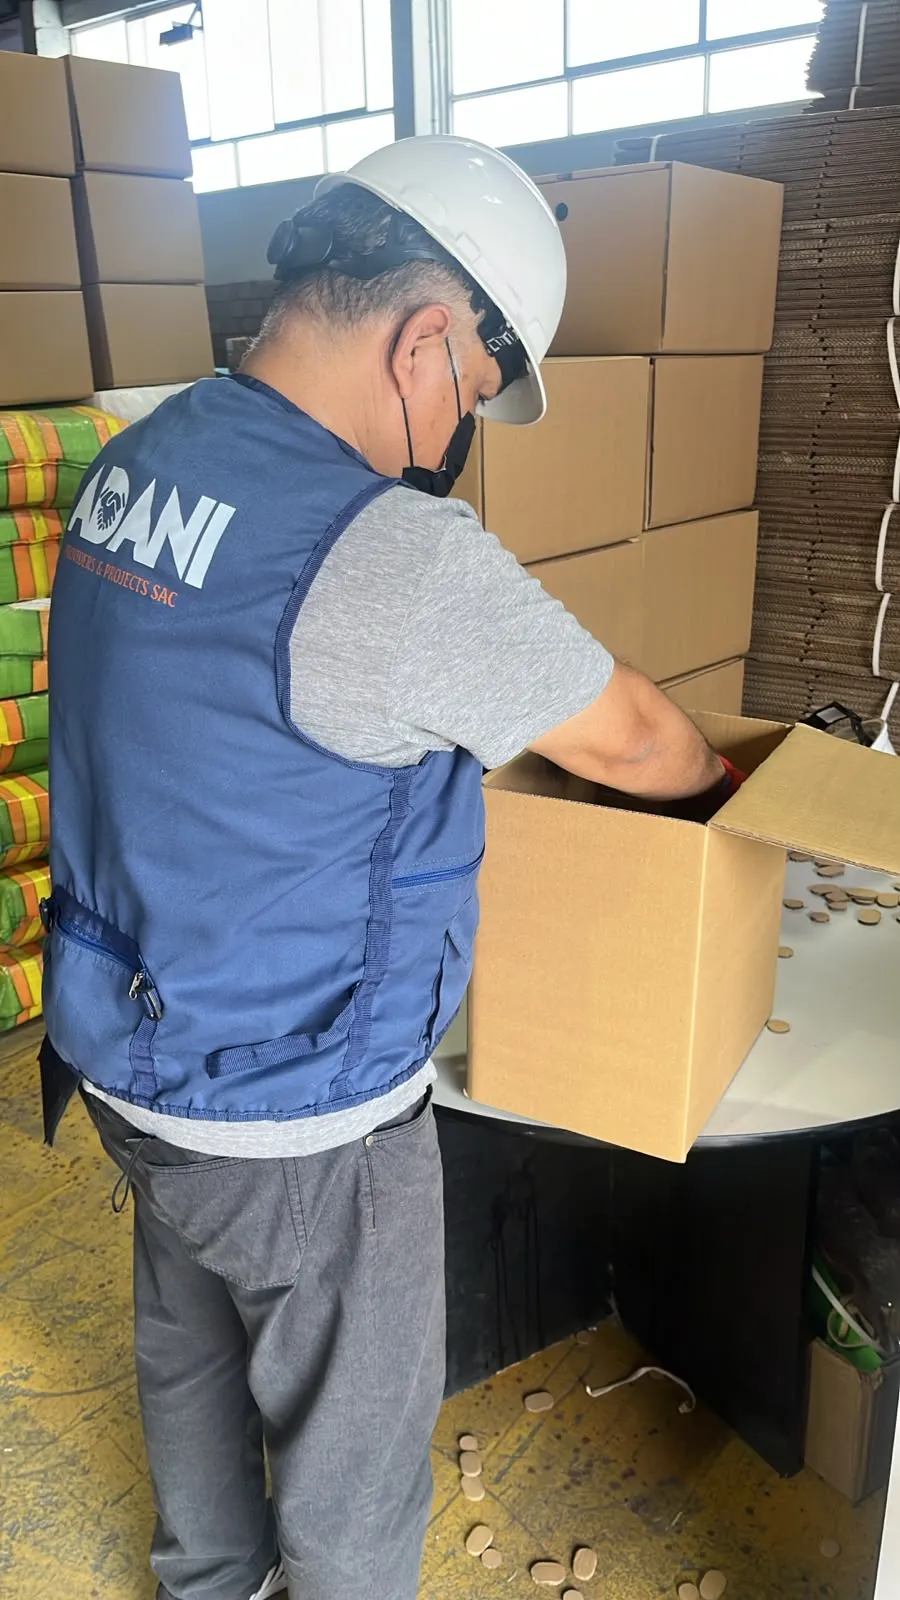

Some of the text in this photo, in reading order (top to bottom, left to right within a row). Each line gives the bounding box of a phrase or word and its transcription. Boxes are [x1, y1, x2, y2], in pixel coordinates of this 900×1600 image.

[67, 463, 237, 589] ADANI
[96, 561, 104, 576] &
[103, 563, 149, 596] PROJECTS
[150, 584, 178, 608] SAC
